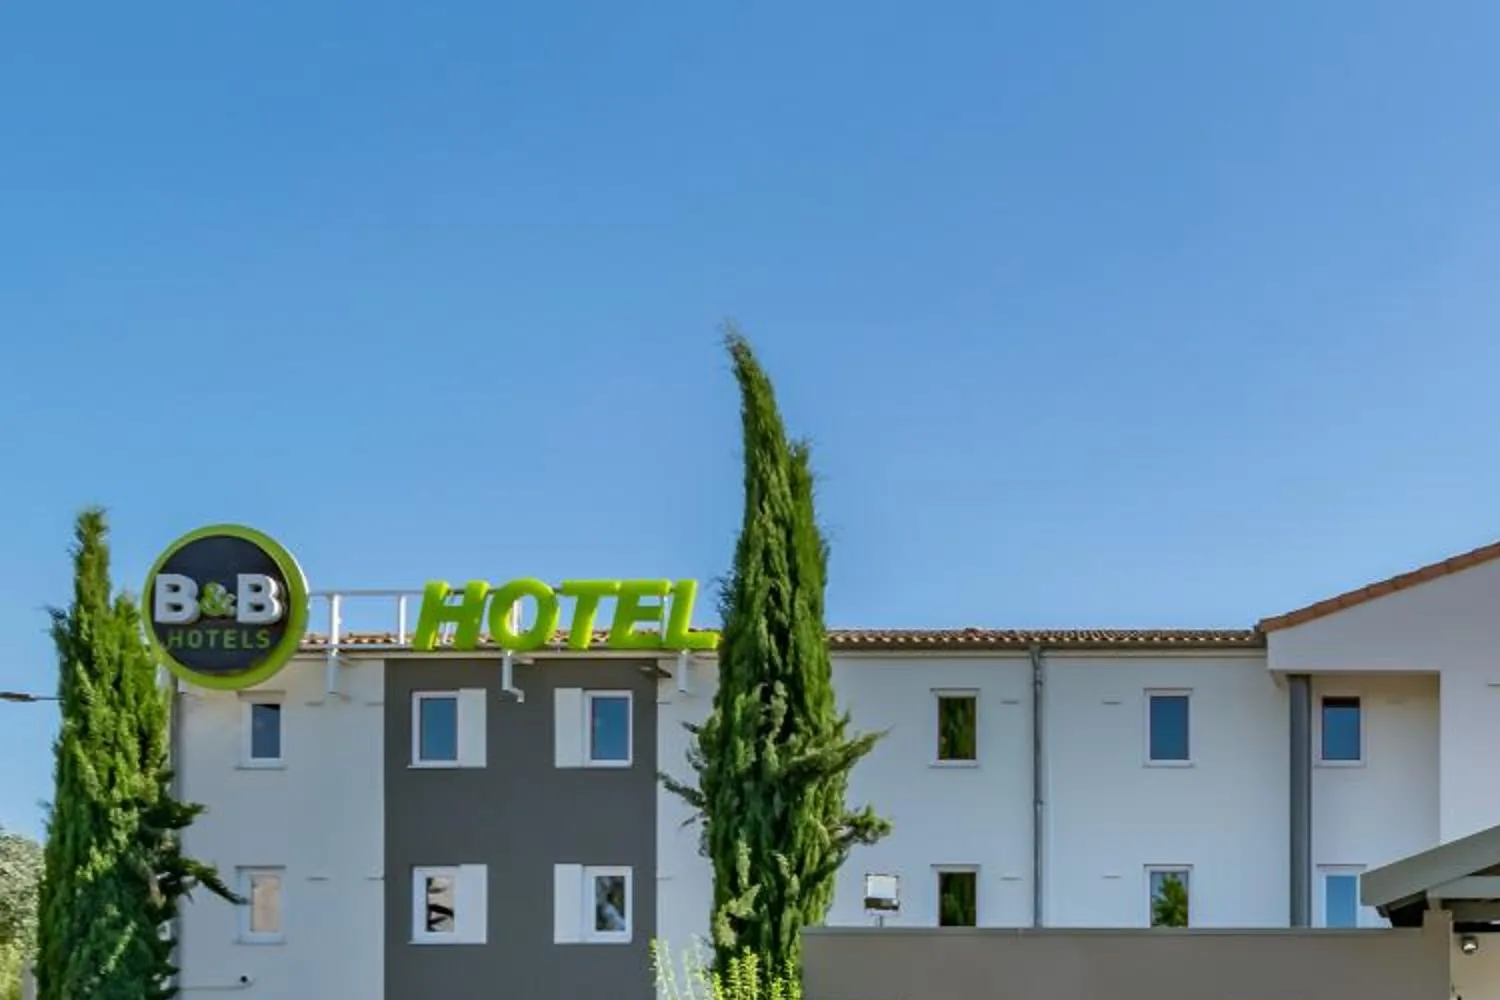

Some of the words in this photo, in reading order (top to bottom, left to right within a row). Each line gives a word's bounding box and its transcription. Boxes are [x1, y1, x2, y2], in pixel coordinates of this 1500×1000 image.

[154, 573, 282, 624] B&B
[413, 578, 720, 651] HOTEL
[168, 630, 270, 649] HOTELS
